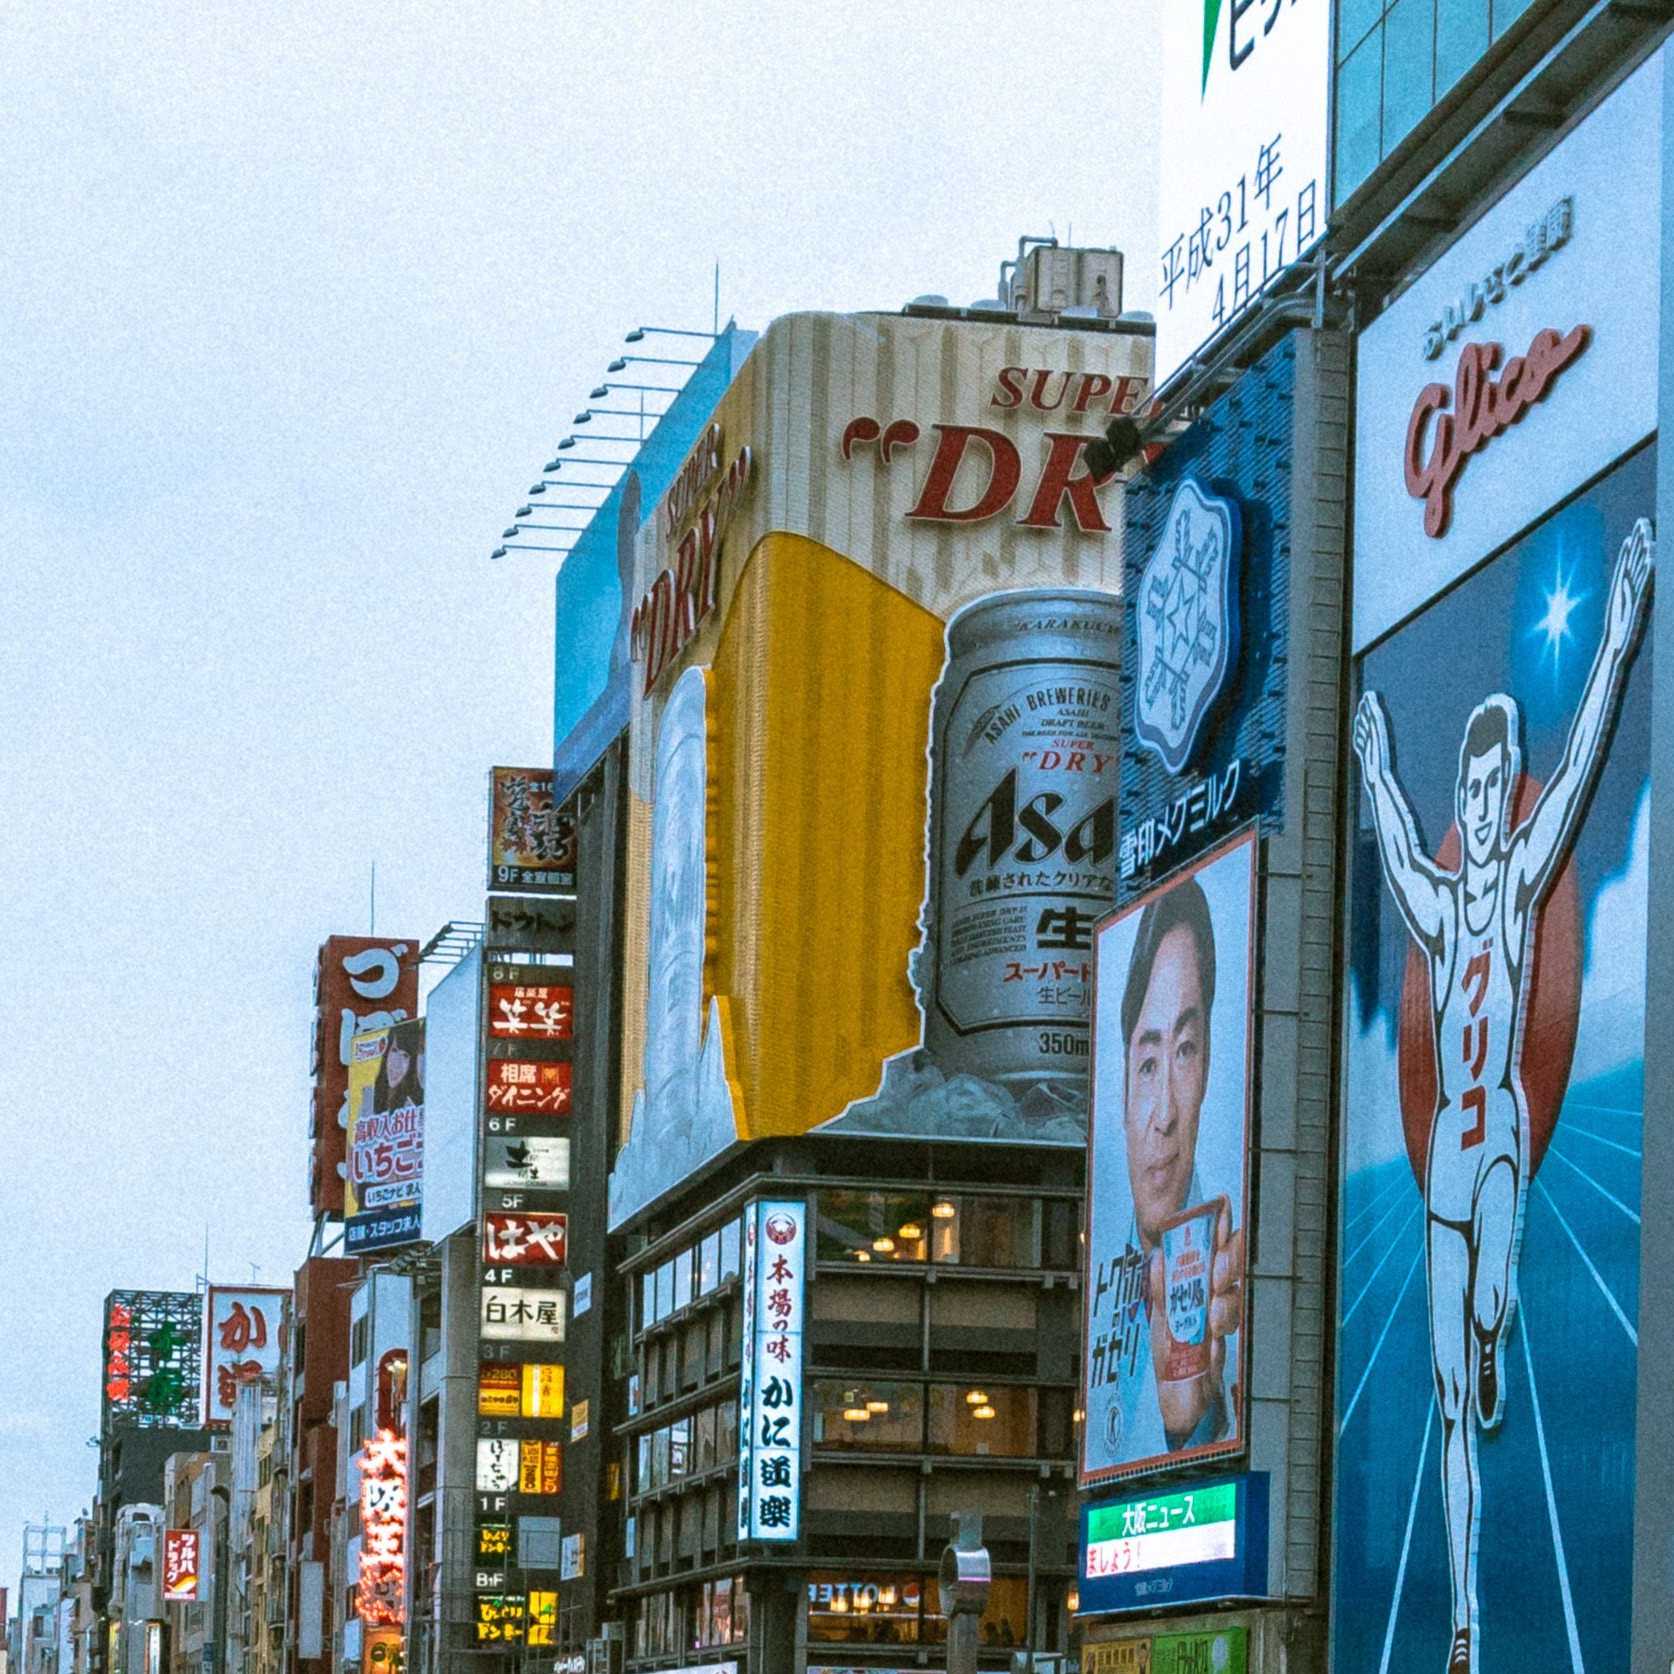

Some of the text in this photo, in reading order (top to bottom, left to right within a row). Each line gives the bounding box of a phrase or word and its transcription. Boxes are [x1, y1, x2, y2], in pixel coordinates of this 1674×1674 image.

[1159, 133, 1282, 310] 平成31年
[1211, 179, 1317, 326] 4月17日
[989, 366, 1161, 416] SUPE
[1404, 323, 1593, 540] Glico
[841, 417, 1163, 532] “DR
[983, 687, 1111, 744] ASAHI BREWERIES
[1051, 738, 1095, 749] SUPER
[1120, 760, 1240, 879] 雪印メグミルク
[498, 866, 519, 882] 9F
[1460, 937, 1494, 1152] グリコ
[488, 1084, 571, 1110] ダイニング
[501, 1063, 537, 1084] 相席
[502, 1195, 524, 1208] 5F
[486, 1296, 559, 1325] 白木屋
[767, 1255, 794, 1363] 本場の味
[759, 1376, 794, 1528] かに道楽
[1122, 1494, 1195, 1537] 大阪ニュース
[180, 1533, 196, 1574] ツルハ
[476, 1573, 504, 1587] B1F
